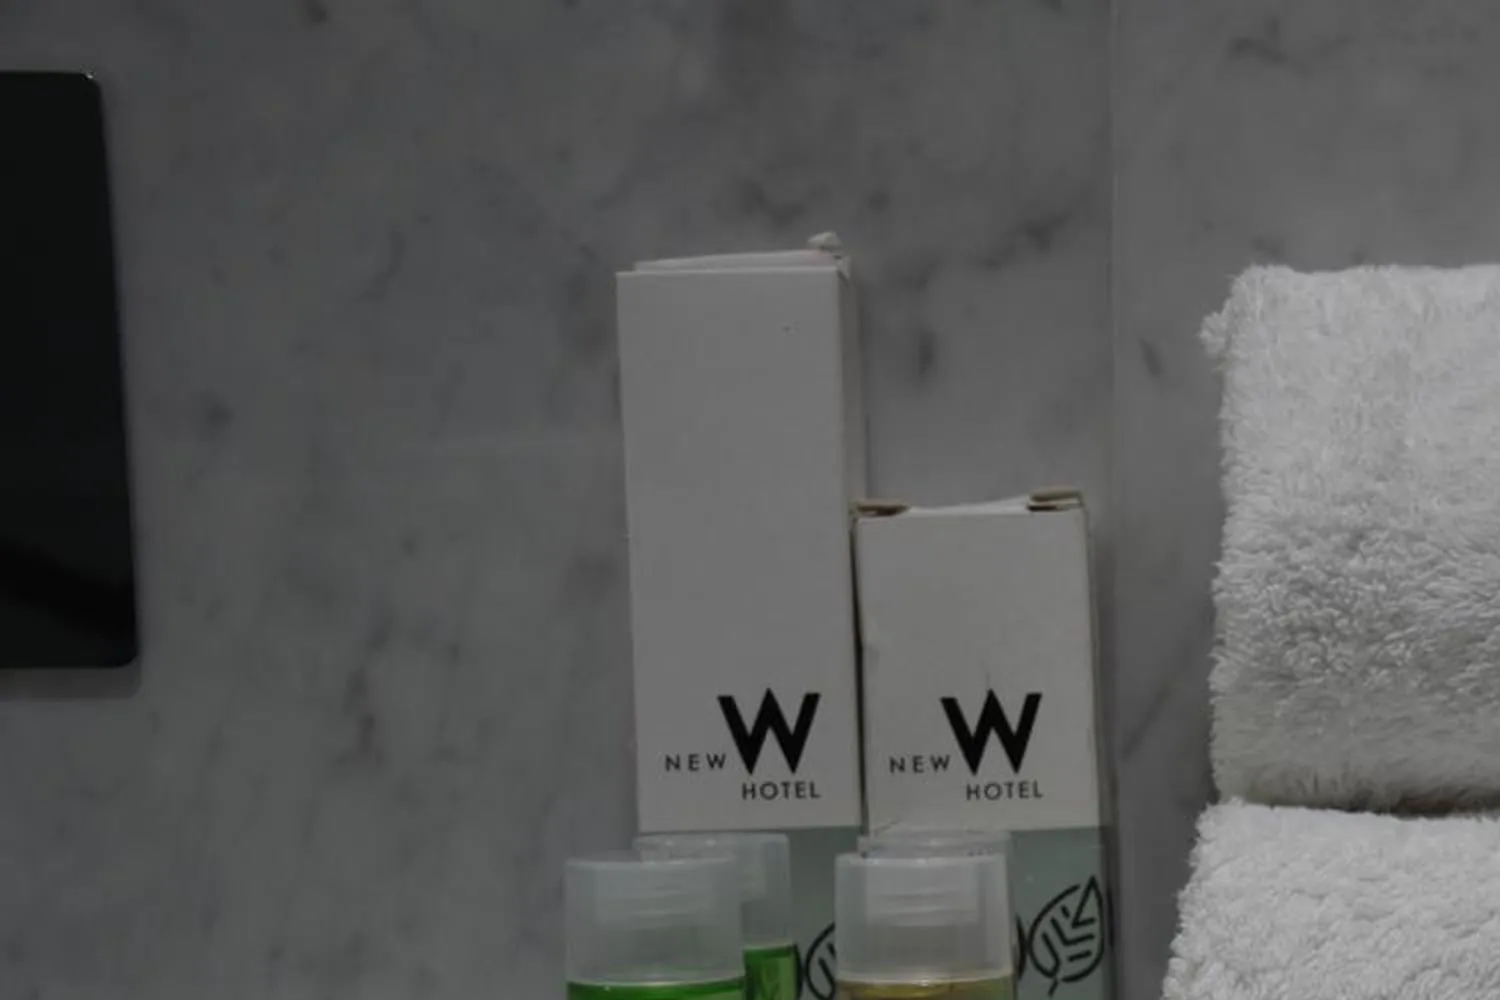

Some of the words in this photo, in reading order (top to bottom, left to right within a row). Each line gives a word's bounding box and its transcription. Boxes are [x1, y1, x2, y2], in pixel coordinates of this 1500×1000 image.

[664, 753, 727, 772] NEW
[716, 687, 821, 775] W
[889, 755, 952, 774] NEW
[940, 688, 1042, 776] W
[741, 780, 821, 800] HOTEL
[965, 780, 1043, 800] HOTEL
